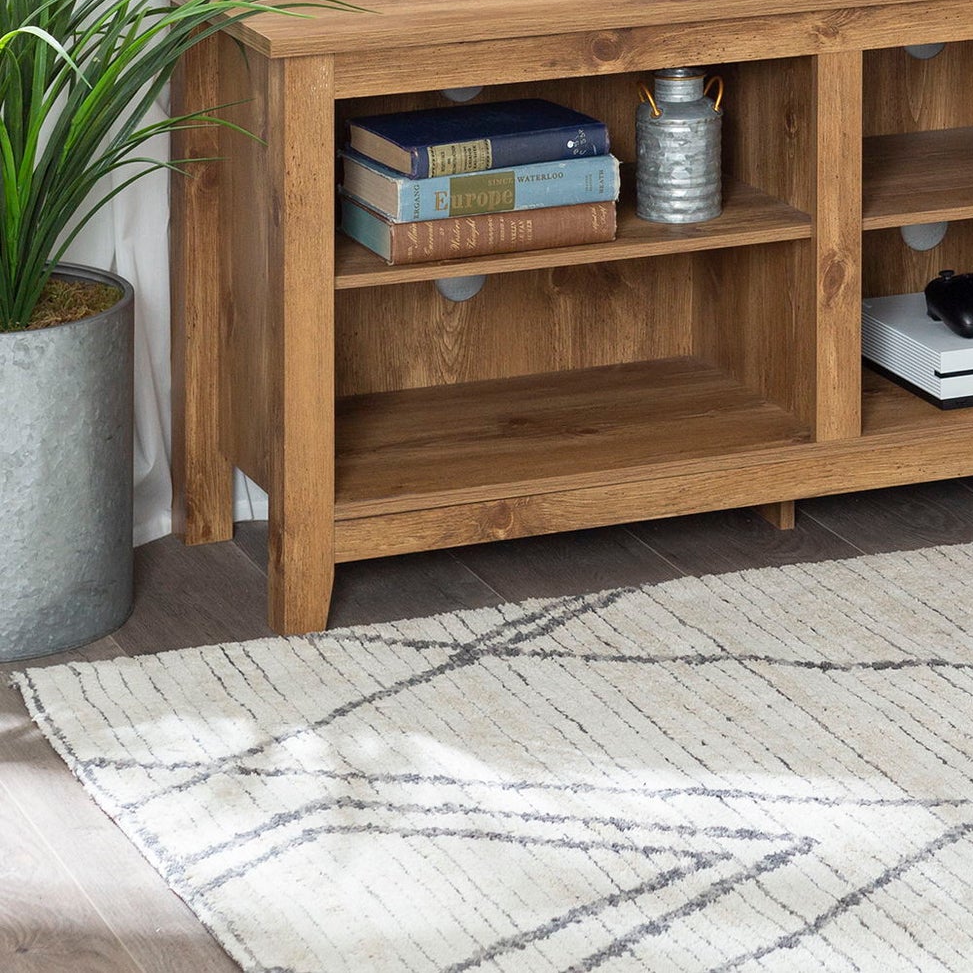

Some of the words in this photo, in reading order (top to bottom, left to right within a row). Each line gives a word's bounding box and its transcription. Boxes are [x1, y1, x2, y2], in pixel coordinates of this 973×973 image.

[487, 177, 513, 187] SINCE
[517, 172, 564, 183] WATERLOO
[434, 188, 514, 212] Europe
